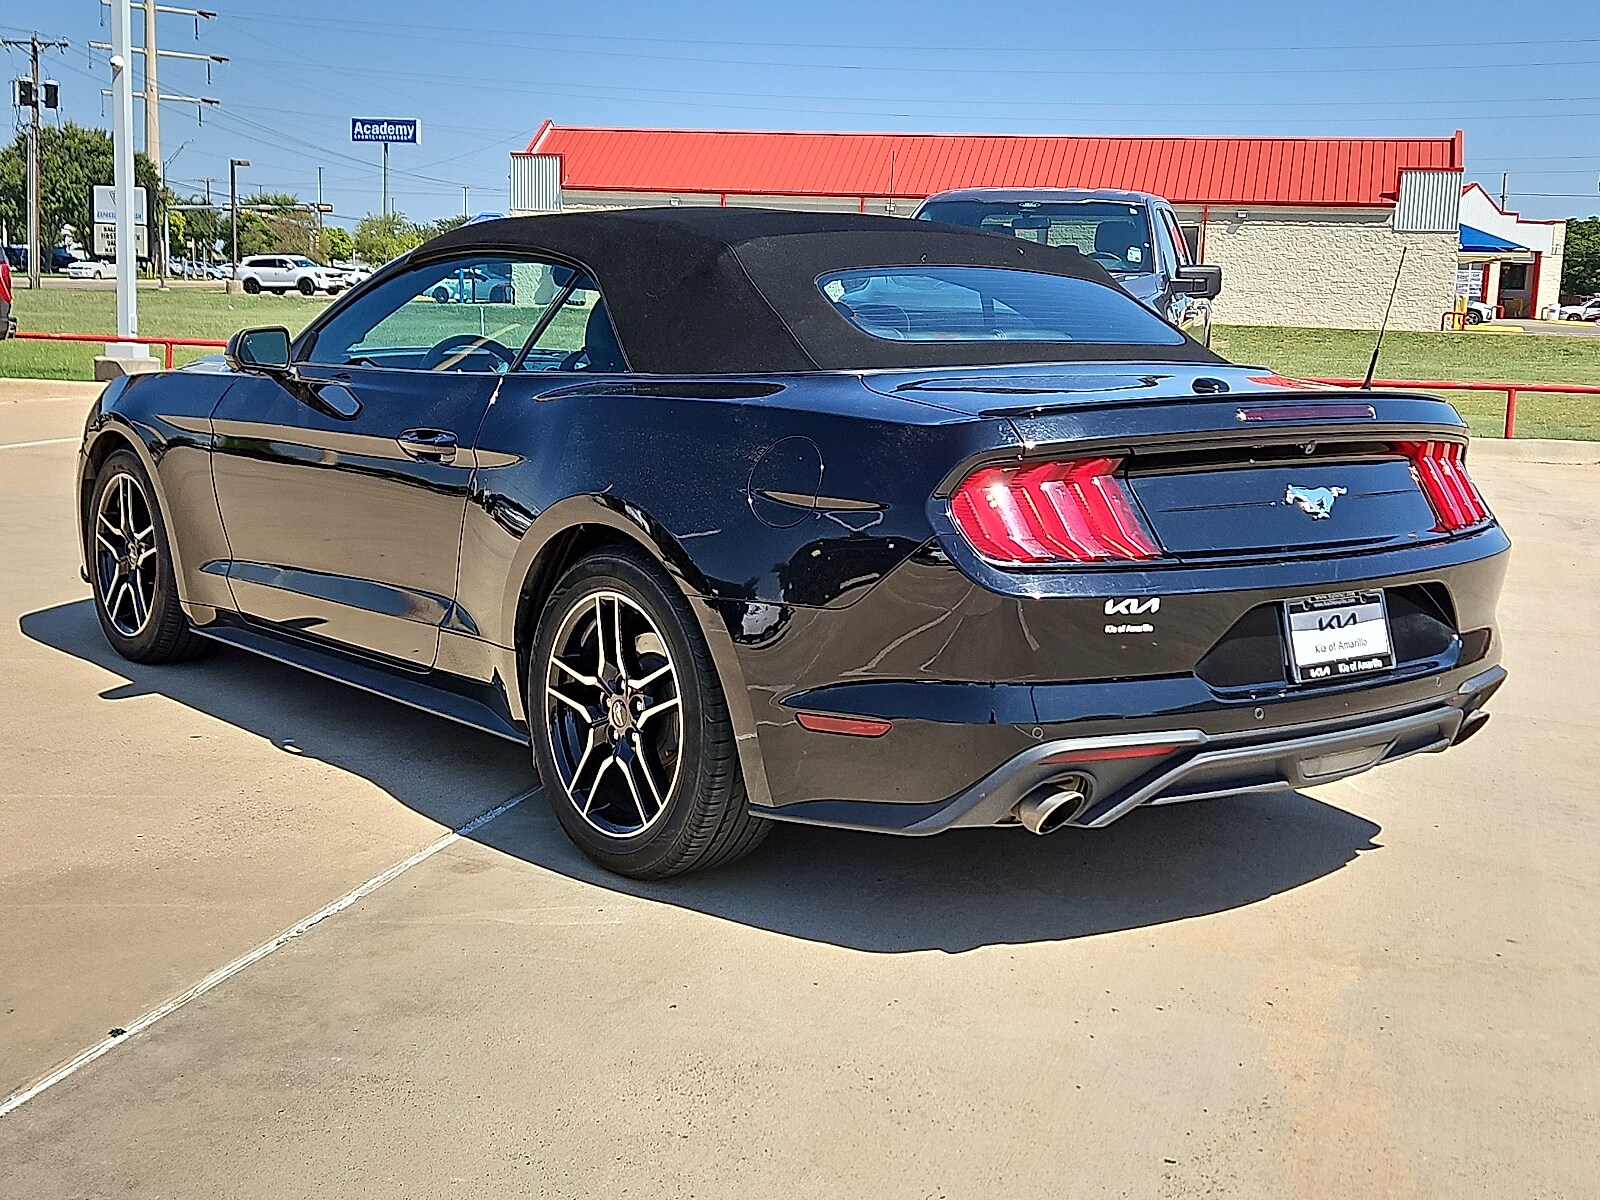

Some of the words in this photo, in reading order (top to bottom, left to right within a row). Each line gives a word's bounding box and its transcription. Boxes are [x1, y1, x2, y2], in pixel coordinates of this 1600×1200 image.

[354, 121, 414, 139] Academy
[1315, 643, 1327, 653] Kia
[1329, 640, 1337, 651] of
[1339, 637, 1368, 650] Amarillo
